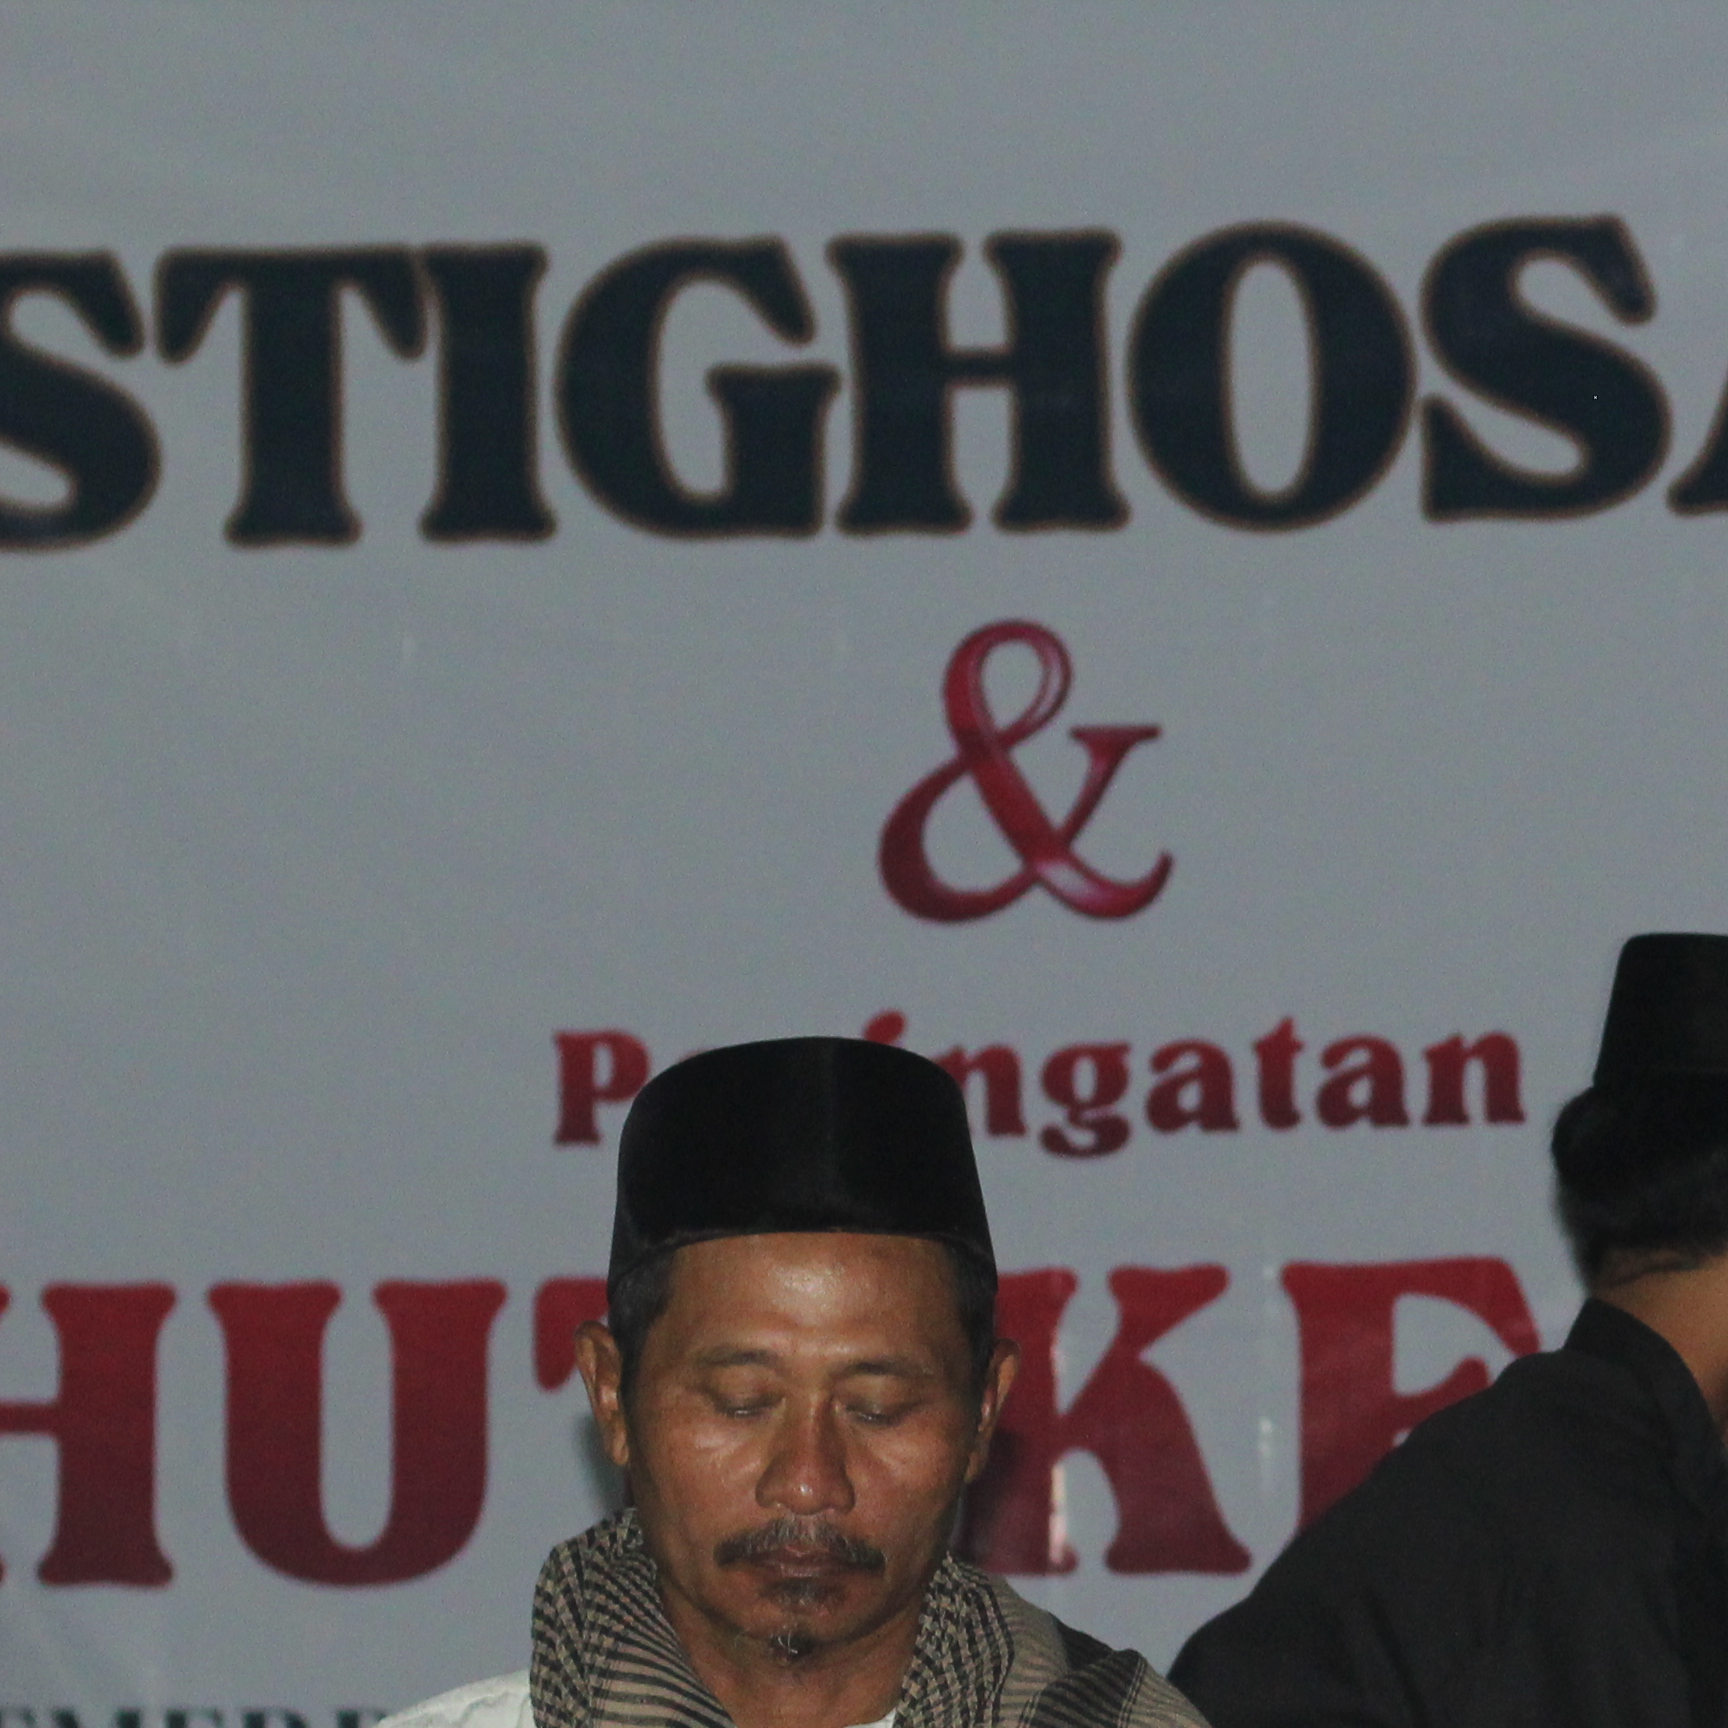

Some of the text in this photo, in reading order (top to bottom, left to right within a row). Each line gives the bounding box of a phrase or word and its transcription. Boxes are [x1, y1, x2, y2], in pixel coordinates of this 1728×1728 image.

[876, 614, 1175, 924] &
[553, 1009, 1528, 1158] Pngatan
[0, 1277, 608, 1588] HU
